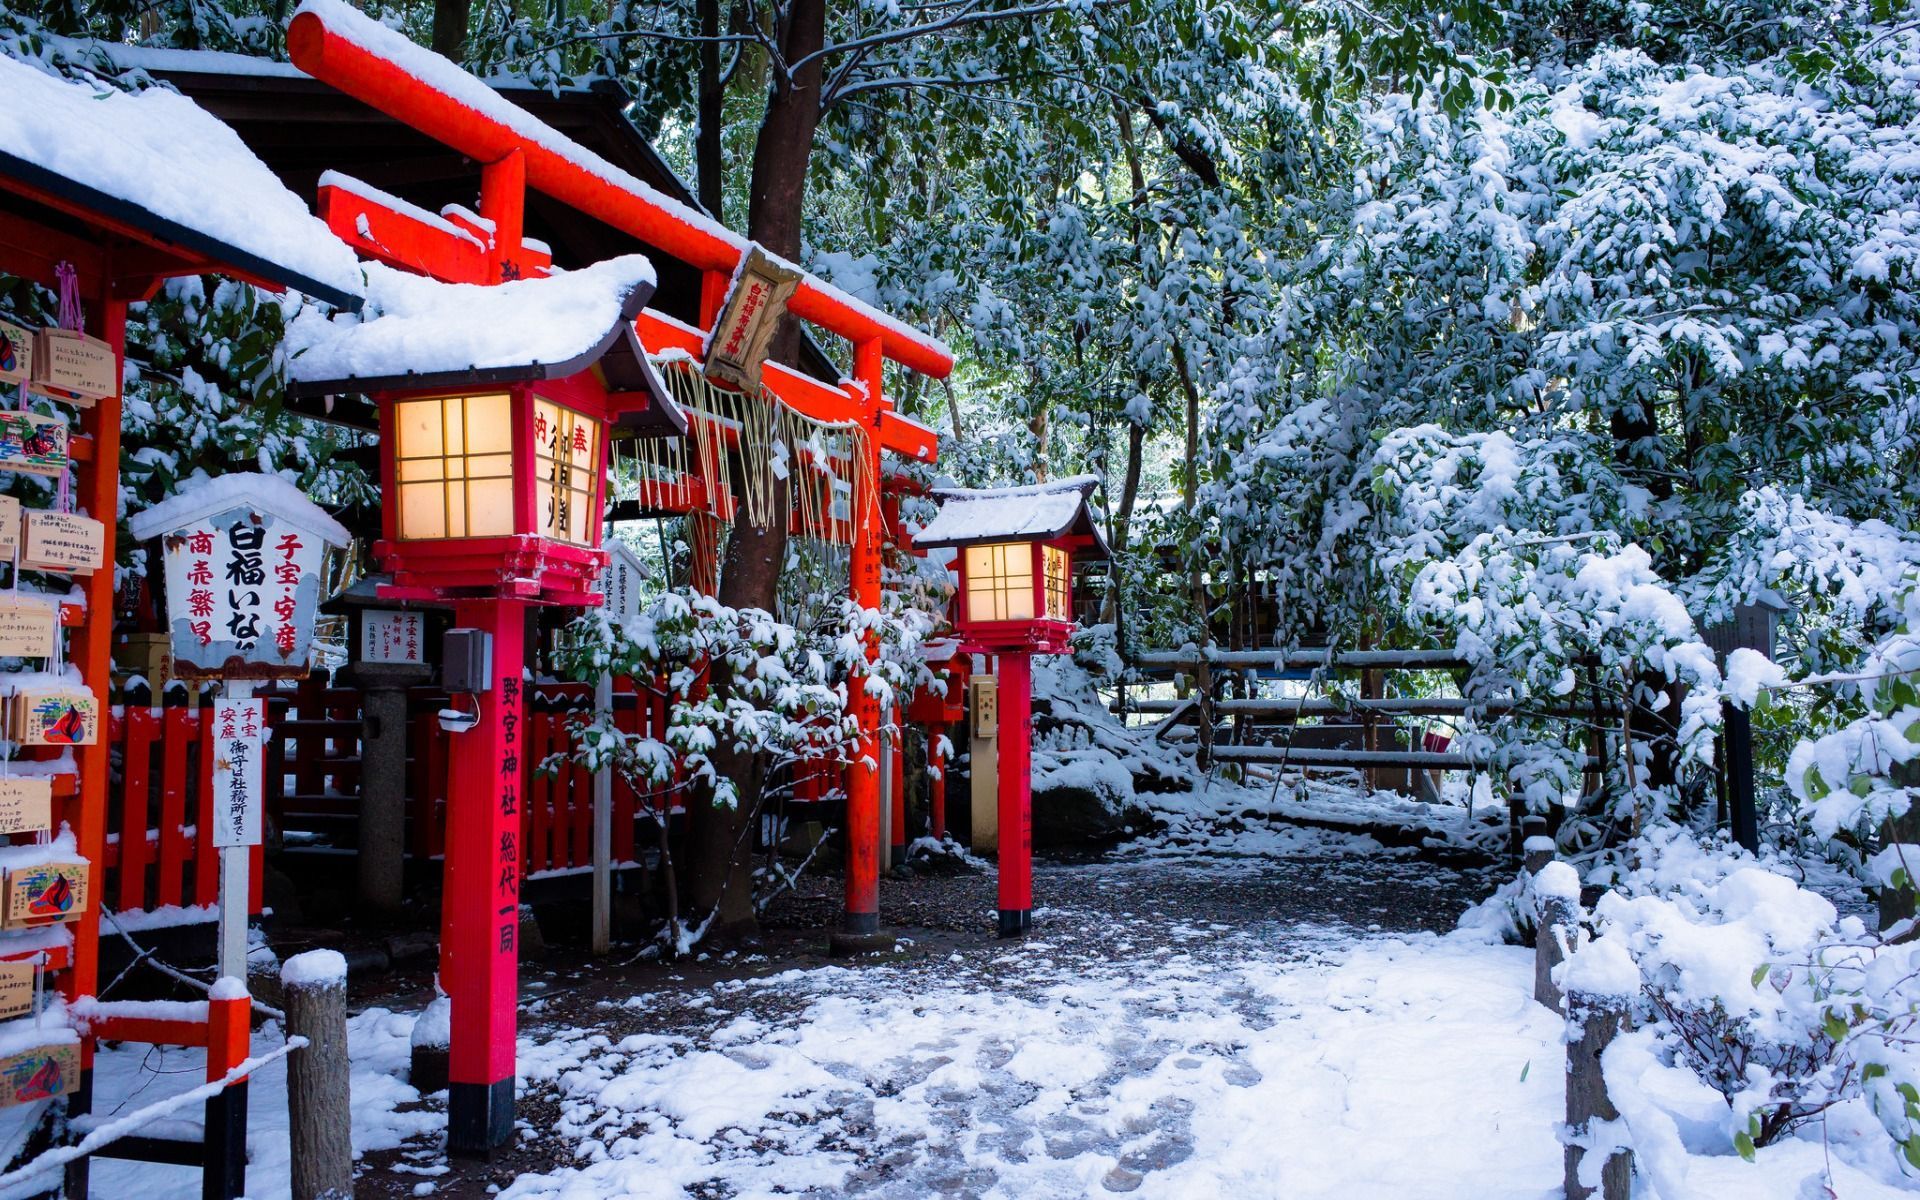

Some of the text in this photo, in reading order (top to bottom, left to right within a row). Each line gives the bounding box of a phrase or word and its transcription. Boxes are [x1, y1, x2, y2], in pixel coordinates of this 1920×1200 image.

[573, 424, 587, 455] 奉
[219, 707, 238, 739] 安産
[241, 707, 258, 737] 子宝
[229, 739, 249, 836] 御守は社務所まで
[498, 677, 520, 953] 野宮神社 総代一同
